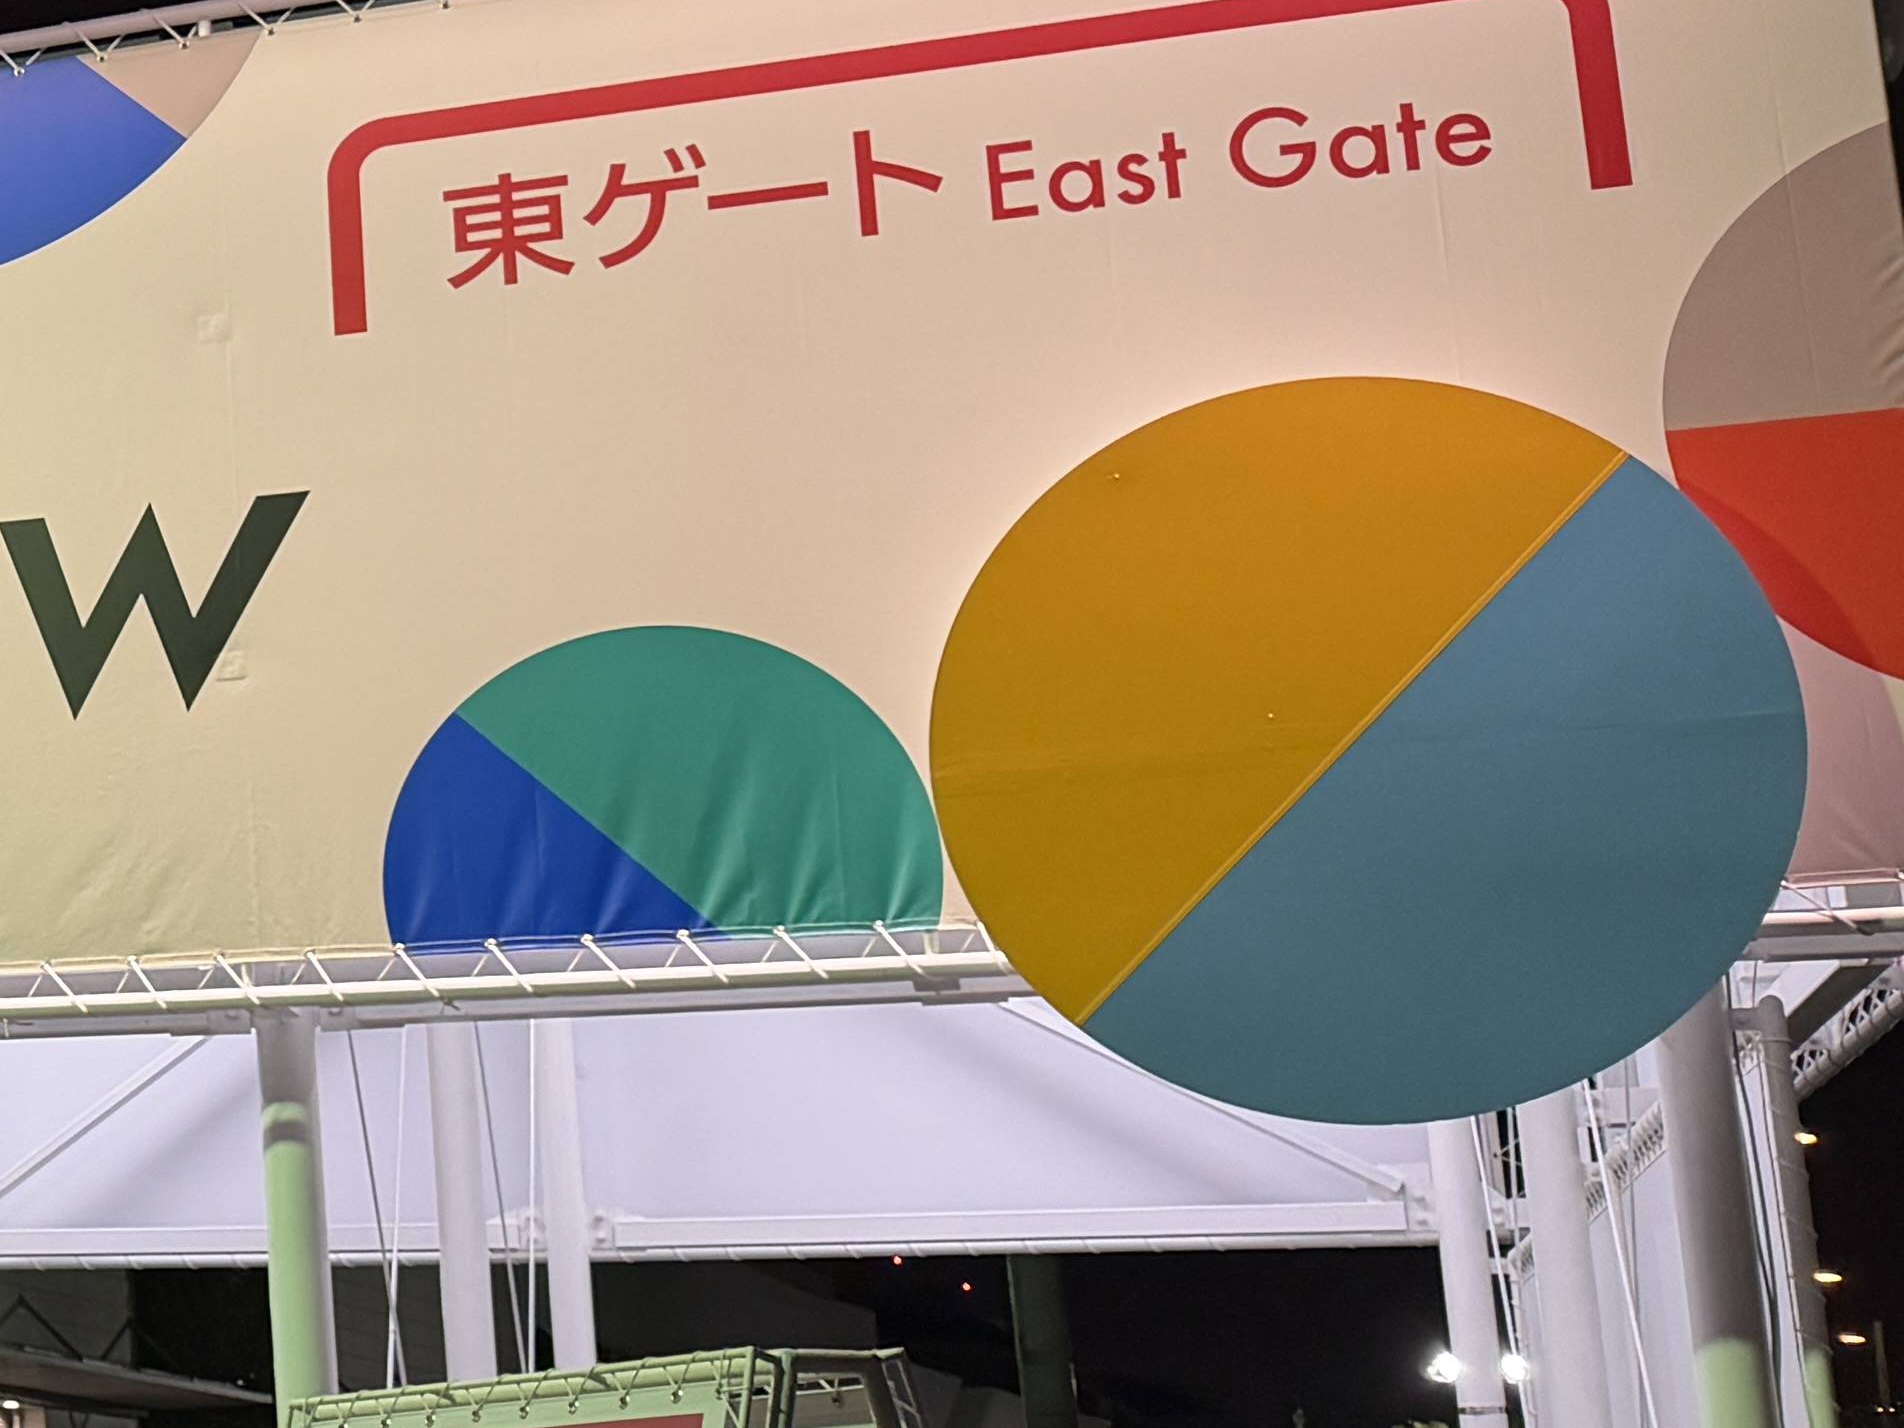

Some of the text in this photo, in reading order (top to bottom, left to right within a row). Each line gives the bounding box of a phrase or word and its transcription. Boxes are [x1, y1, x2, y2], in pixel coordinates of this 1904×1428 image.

[442, 101, 1493, 289] 東ゲート East Gate
